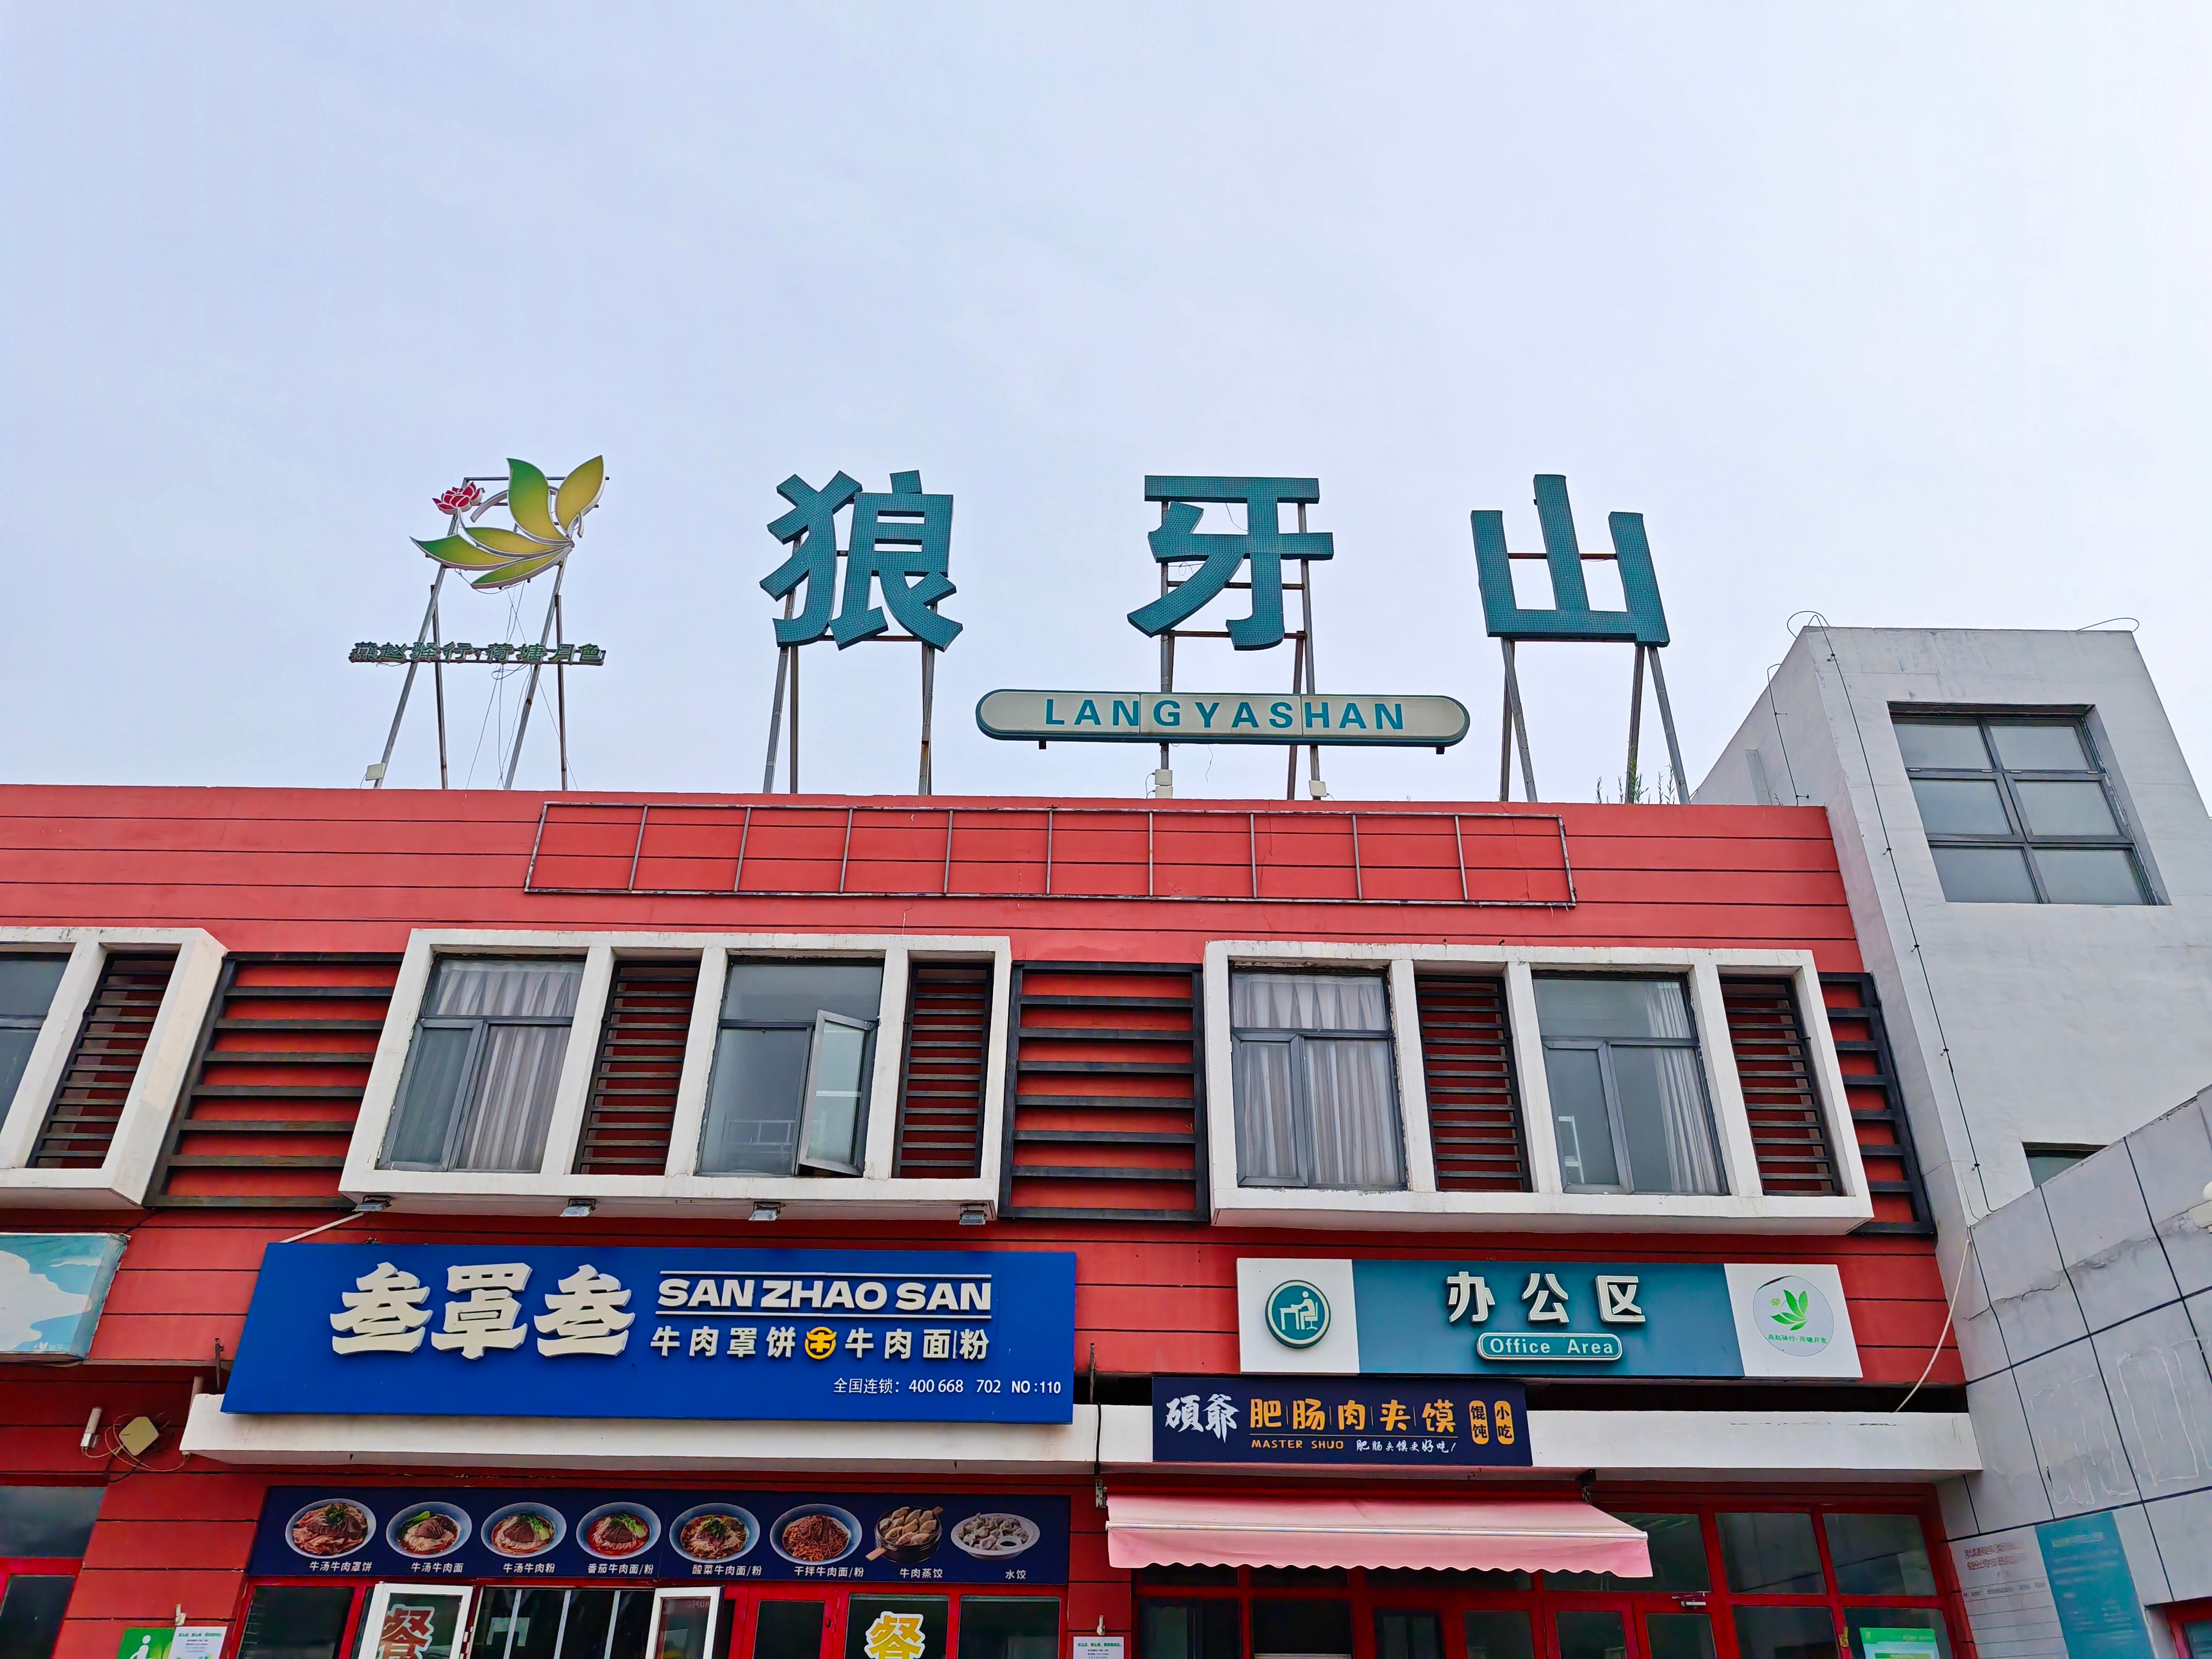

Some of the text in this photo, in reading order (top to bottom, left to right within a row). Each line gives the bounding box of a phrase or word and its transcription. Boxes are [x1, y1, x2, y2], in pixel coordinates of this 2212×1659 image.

[760, 470, 1670, 651] 狼牙山
[1045, 698, 1404, 731] LANGYASHAN
[658, 1278, 992, 1311] SAN ZHAO SAN
[1446, 1271, 1646, 1324] 办公区
[330, 1262, 636, 1360] 叁罩叁
[650, 1325, 797, 1358] 牛肉罩饼
[1489, 1338, 1614, 1354] Office Area
[909, 1379, 934, 1393] 400
[938, 1379, 964, 1393] 668
[976, 1379, 1001, 1393] 702
[1471, 1404, 1488, 1440] 馄饨
[1495, 1405, 1512, 1439] 小吃
[1251, 1439, 1344, 1450] MASTER SHUO
[309, 1561, 373, 1573] 牛汤牛肉罩饼
[411, 1562, 464, 1574] 牛汤牛肉面
[503, 1562, 555, 1574] 牛汤牛肉粉
[899, 1568, 943, 1579] 牛肉蒸饺
[1005, 1569, 1027, 1580] 水饺
